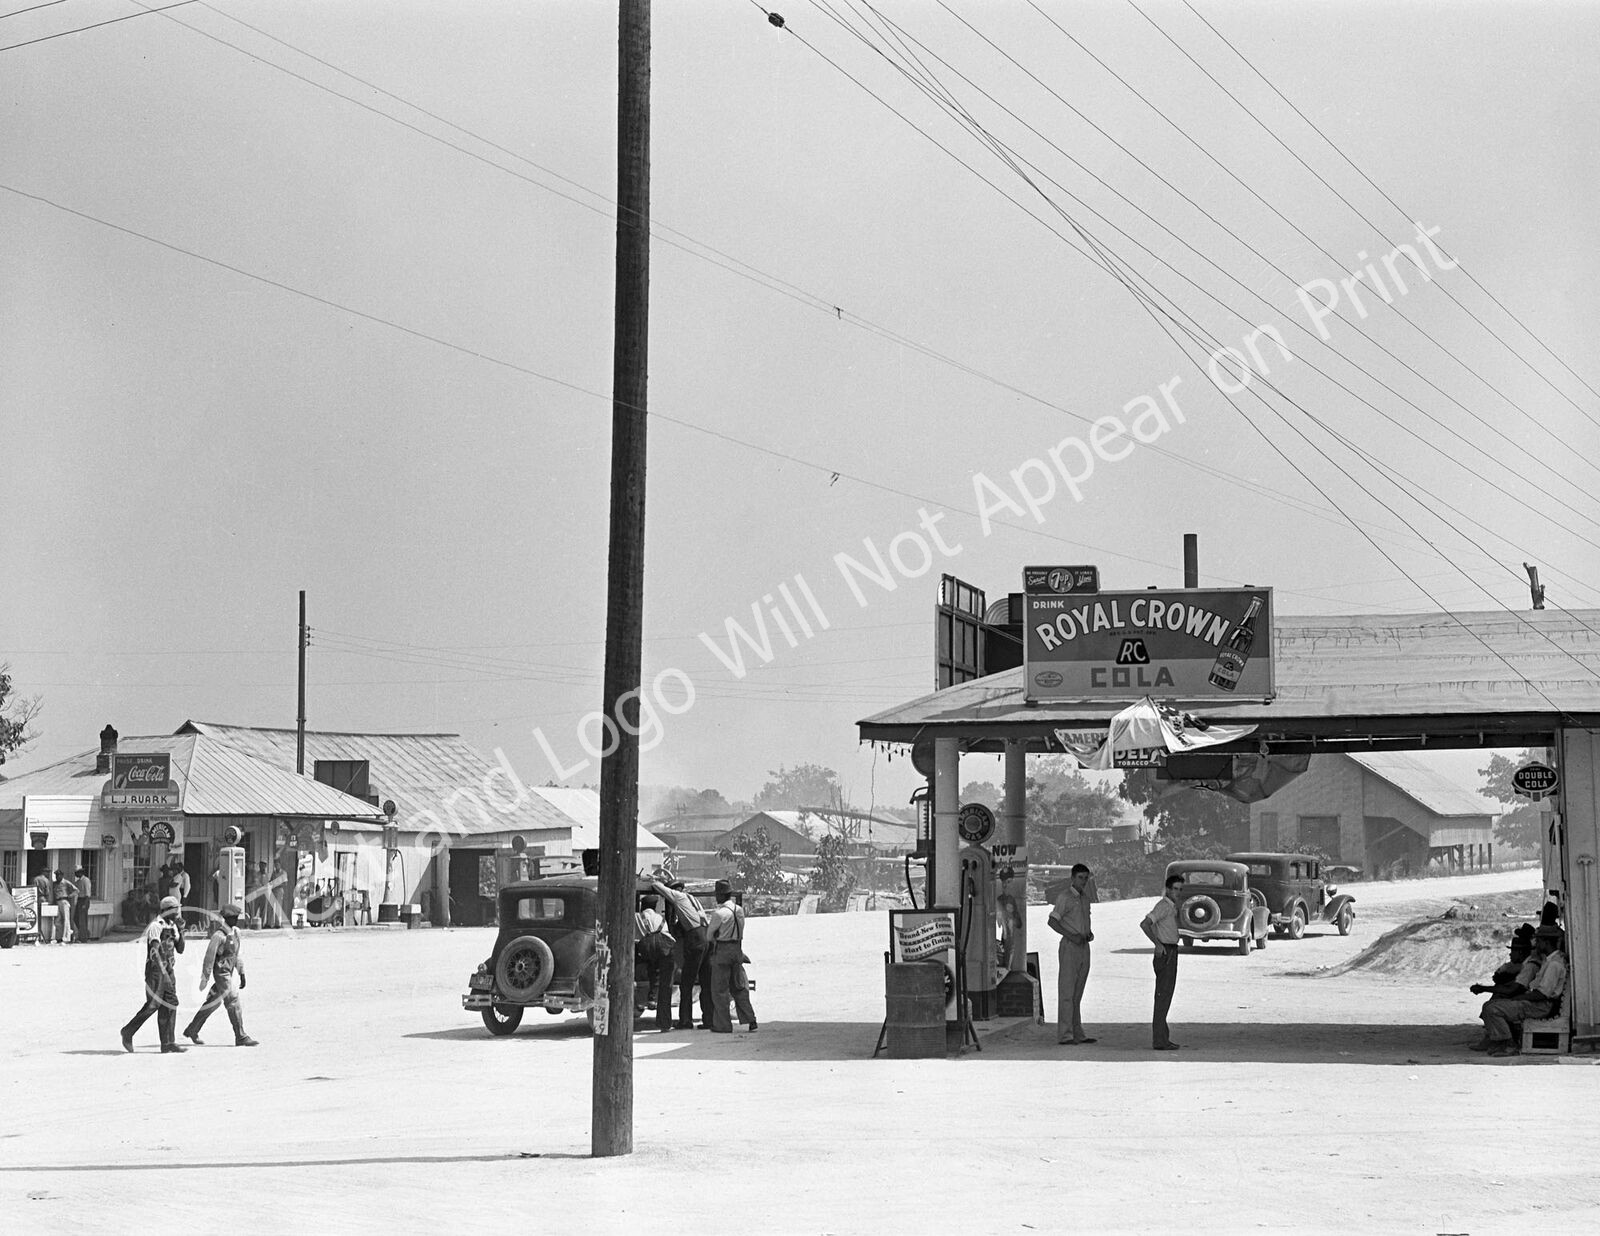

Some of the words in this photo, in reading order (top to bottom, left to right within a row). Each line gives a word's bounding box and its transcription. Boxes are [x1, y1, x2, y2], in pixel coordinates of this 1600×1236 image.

[1033, 600, 1065, 609] DRINK
[1035, 599, 1126, 651] ROYAL
[1130, 598, 1230, 647] CROWN
[1120, 641, 1147, 663] RC
[1091, 666, 1175, 688] COLA
[1518, 771, 1553, 780] DOUBLE
[1524, 780, 1548, 788] COLA
[992, 845, 1017, 856] NOW
[923, 942, 932, 950] to
